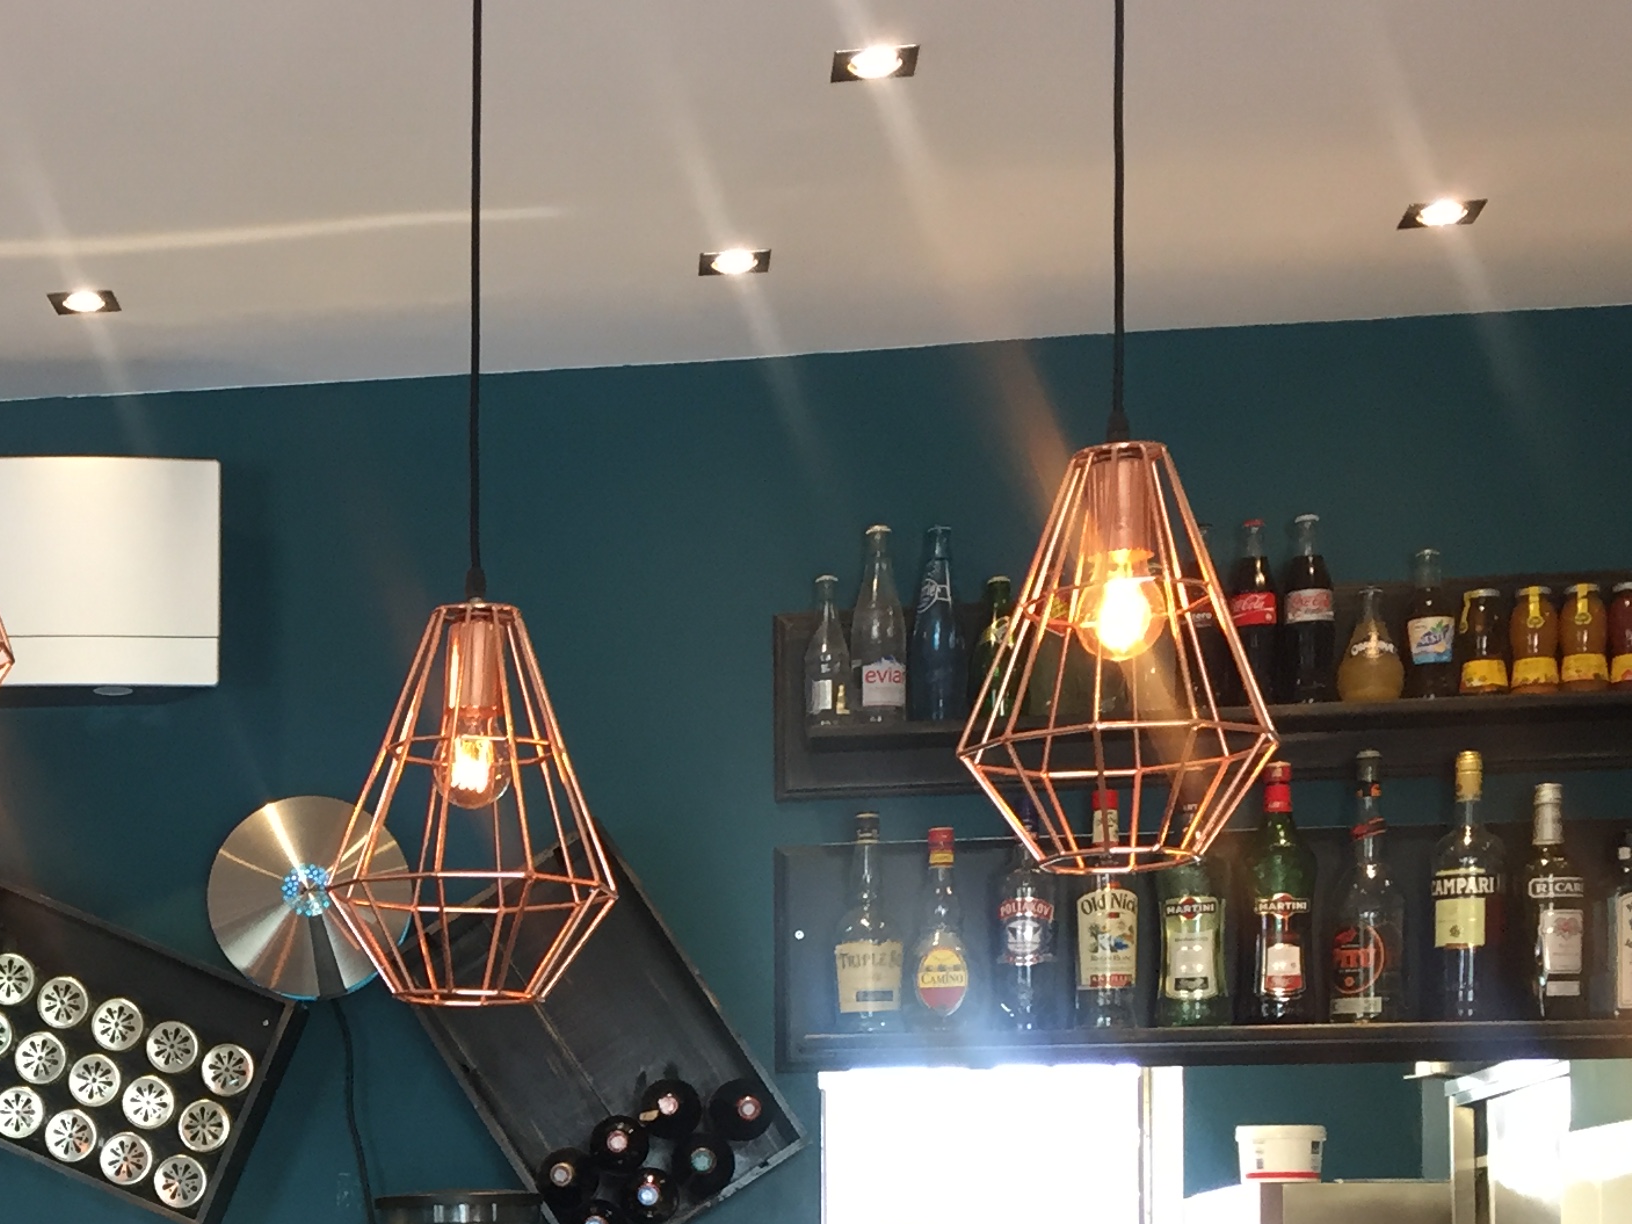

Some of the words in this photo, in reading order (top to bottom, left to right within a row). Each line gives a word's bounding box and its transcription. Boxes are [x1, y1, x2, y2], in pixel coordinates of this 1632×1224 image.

[1431, 875, 1495, 896] CAMPARI
[999, 899, 1051, 917] POLIAKOV
[1080, 893, 1106, 915] Old
[1166, 903, 1215, 914] MARTINI
[1259, 901, 1307, 912] MARTINI
[920, 973, 964, 985] CAMINO
